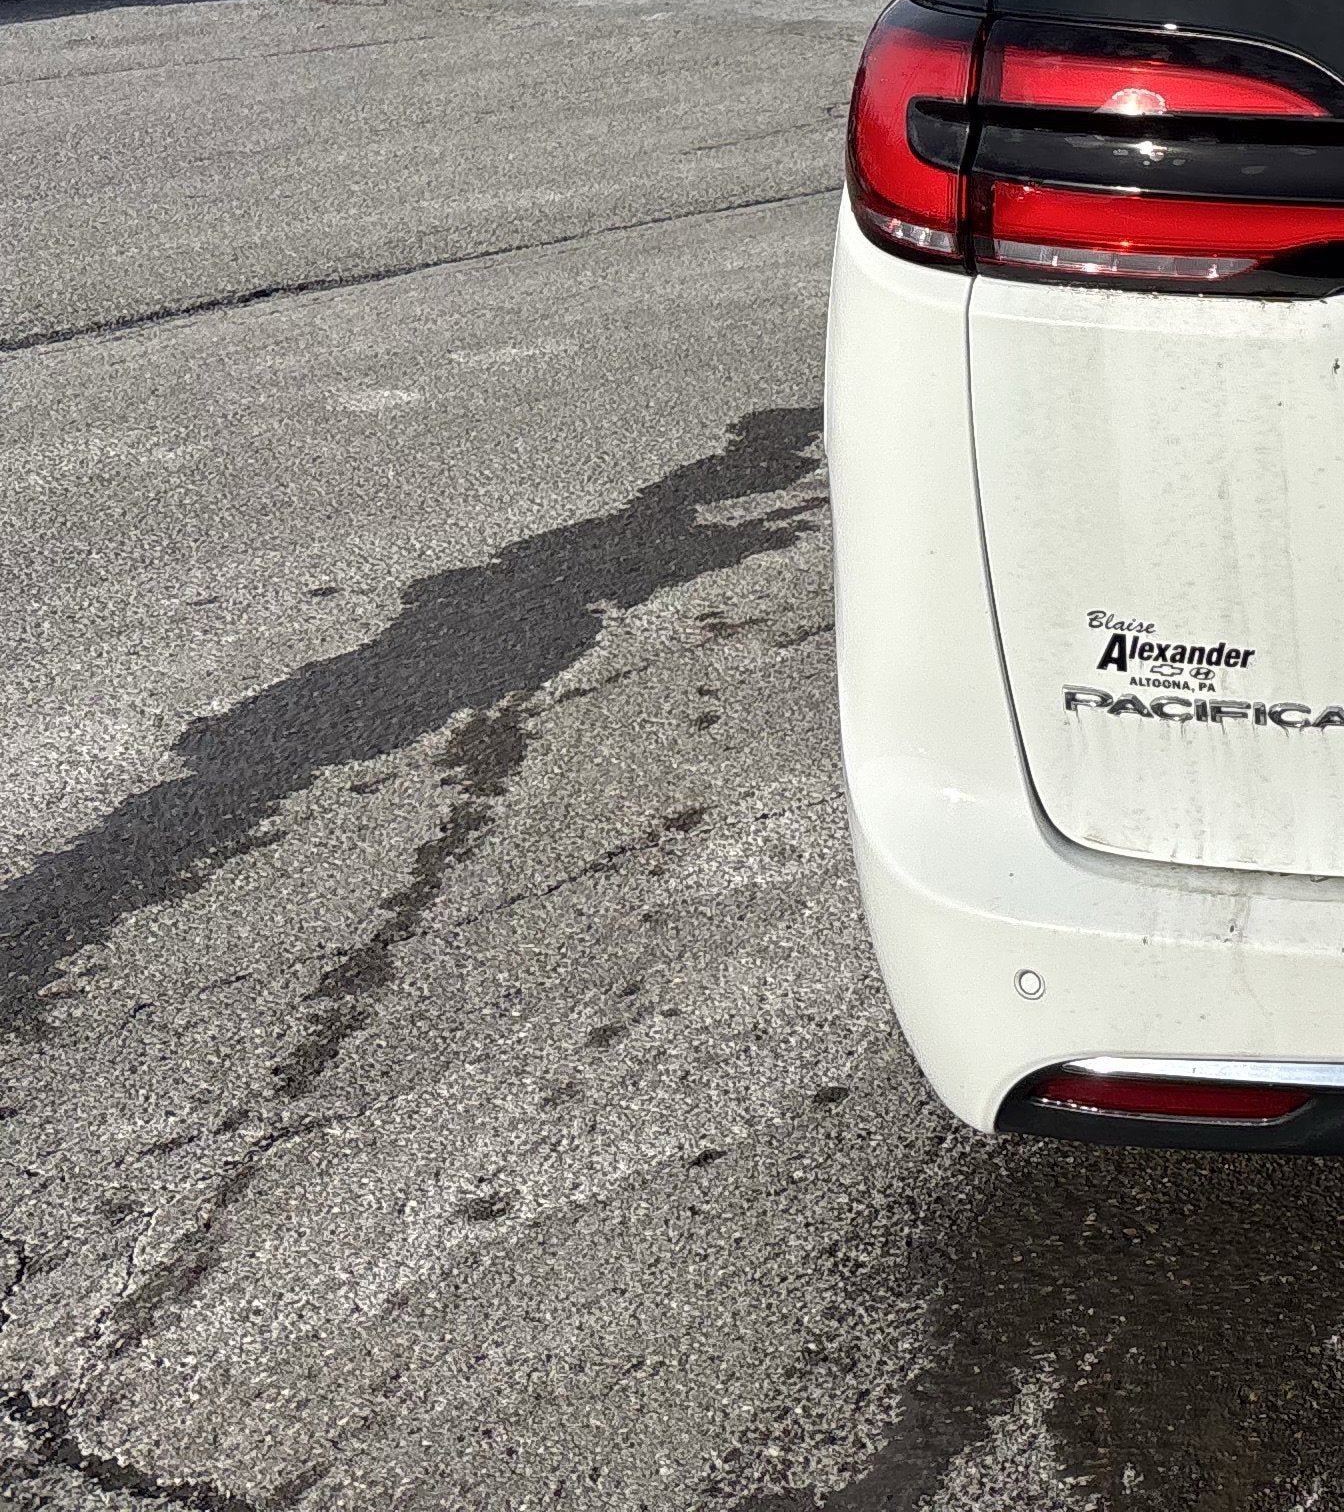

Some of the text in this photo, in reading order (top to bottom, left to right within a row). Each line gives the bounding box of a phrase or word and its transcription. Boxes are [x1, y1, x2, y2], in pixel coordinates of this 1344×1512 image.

[1086, 609, 1157, 634] Blaise
[1096, 632, 1256, 672] Alexander
[1129, 676, 1217, 693] ALTOONA, PA
